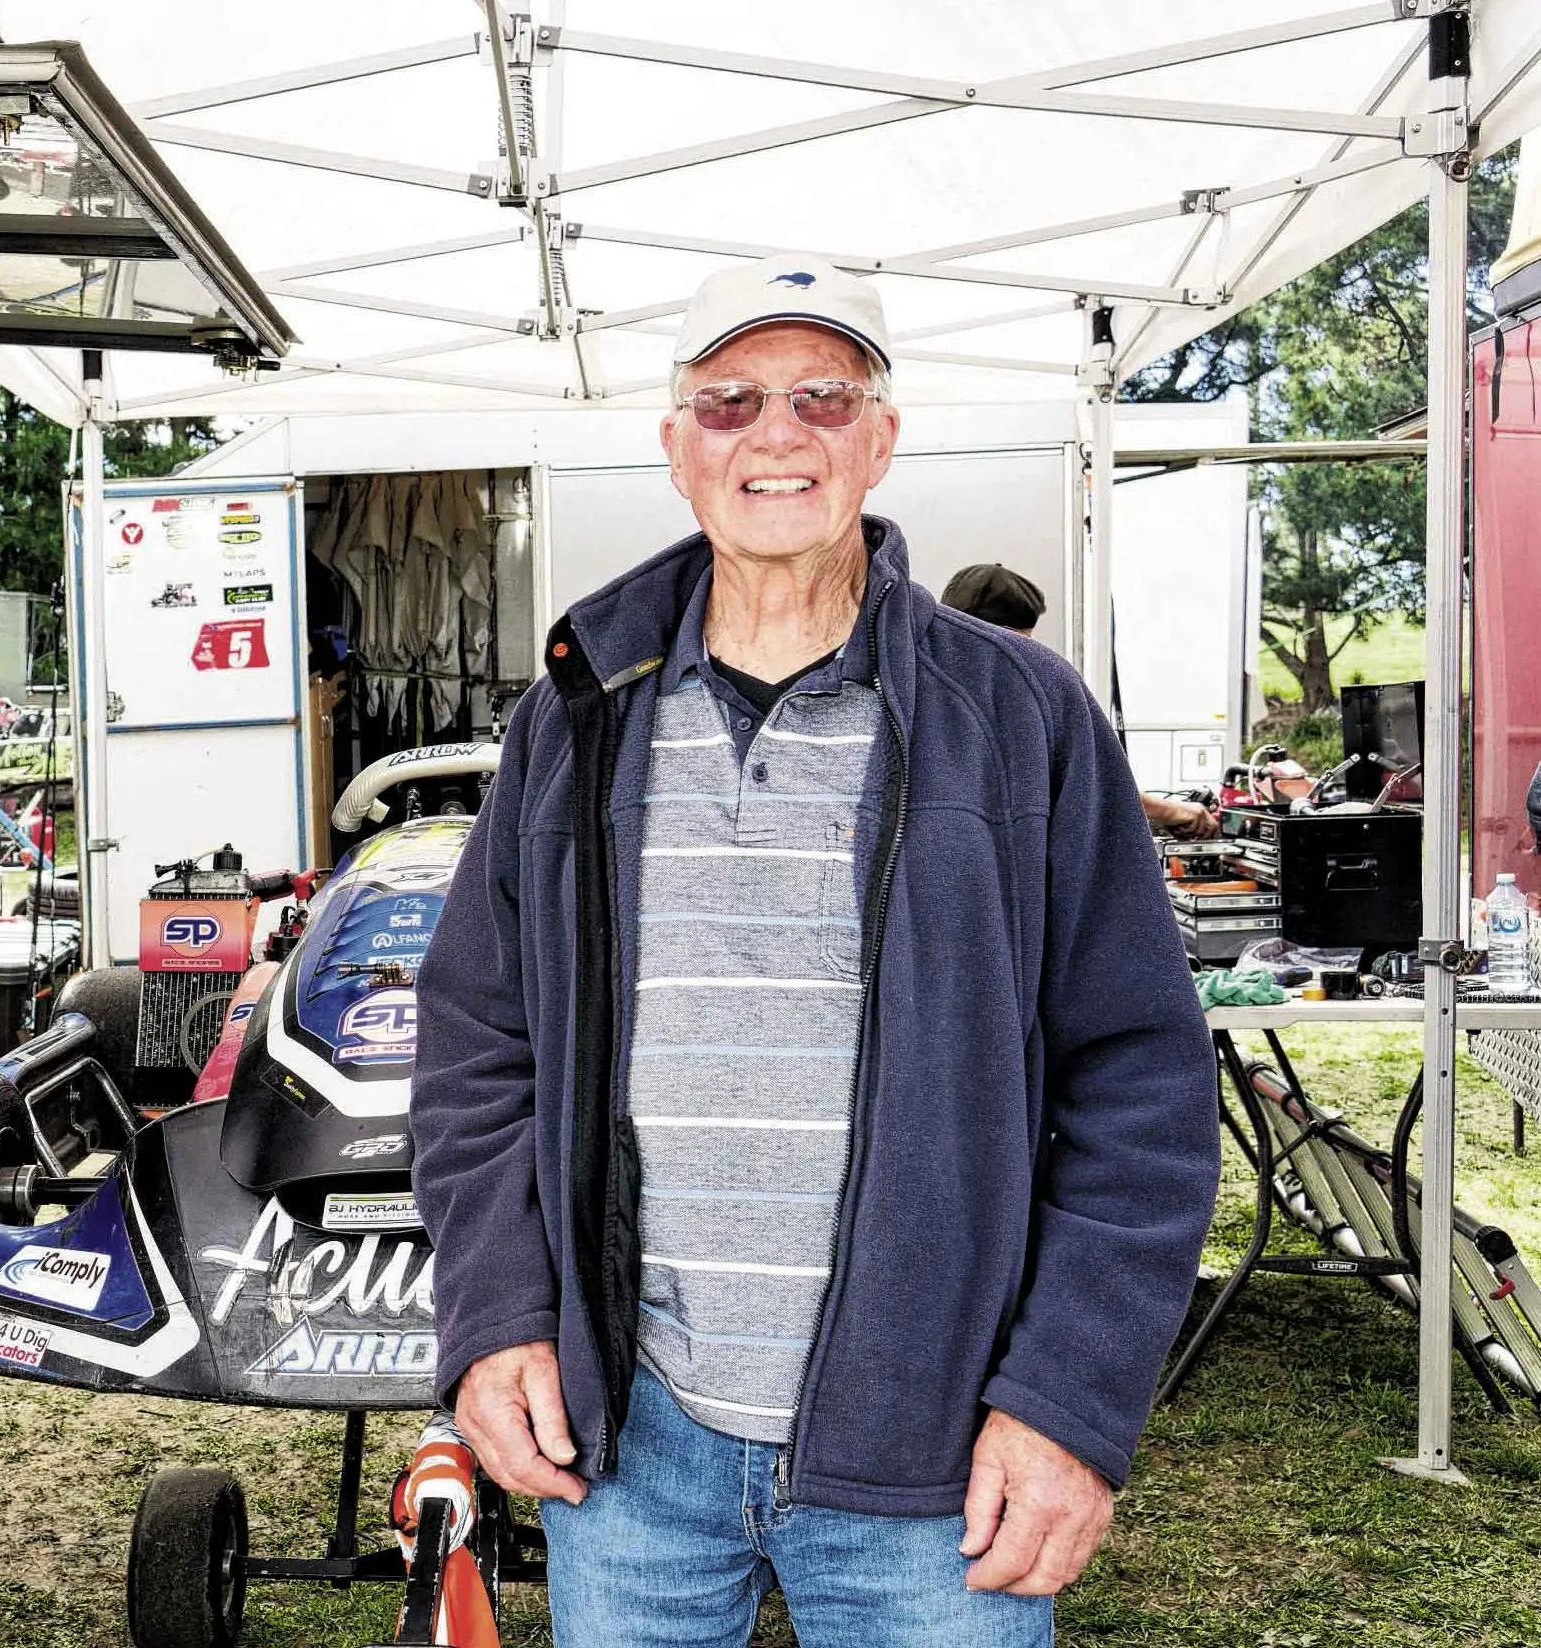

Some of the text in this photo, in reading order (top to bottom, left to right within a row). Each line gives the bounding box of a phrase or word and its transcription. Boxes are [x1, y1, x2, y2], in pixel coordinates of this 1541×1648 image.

[228, 630, 252, 668] 5
[387, 742, 485, 767] ARROW
[34, 1251, 106, 1289] iComply
[10, 1323, 23, 1341] U
[23, 1330, 49, 1352] Dig
